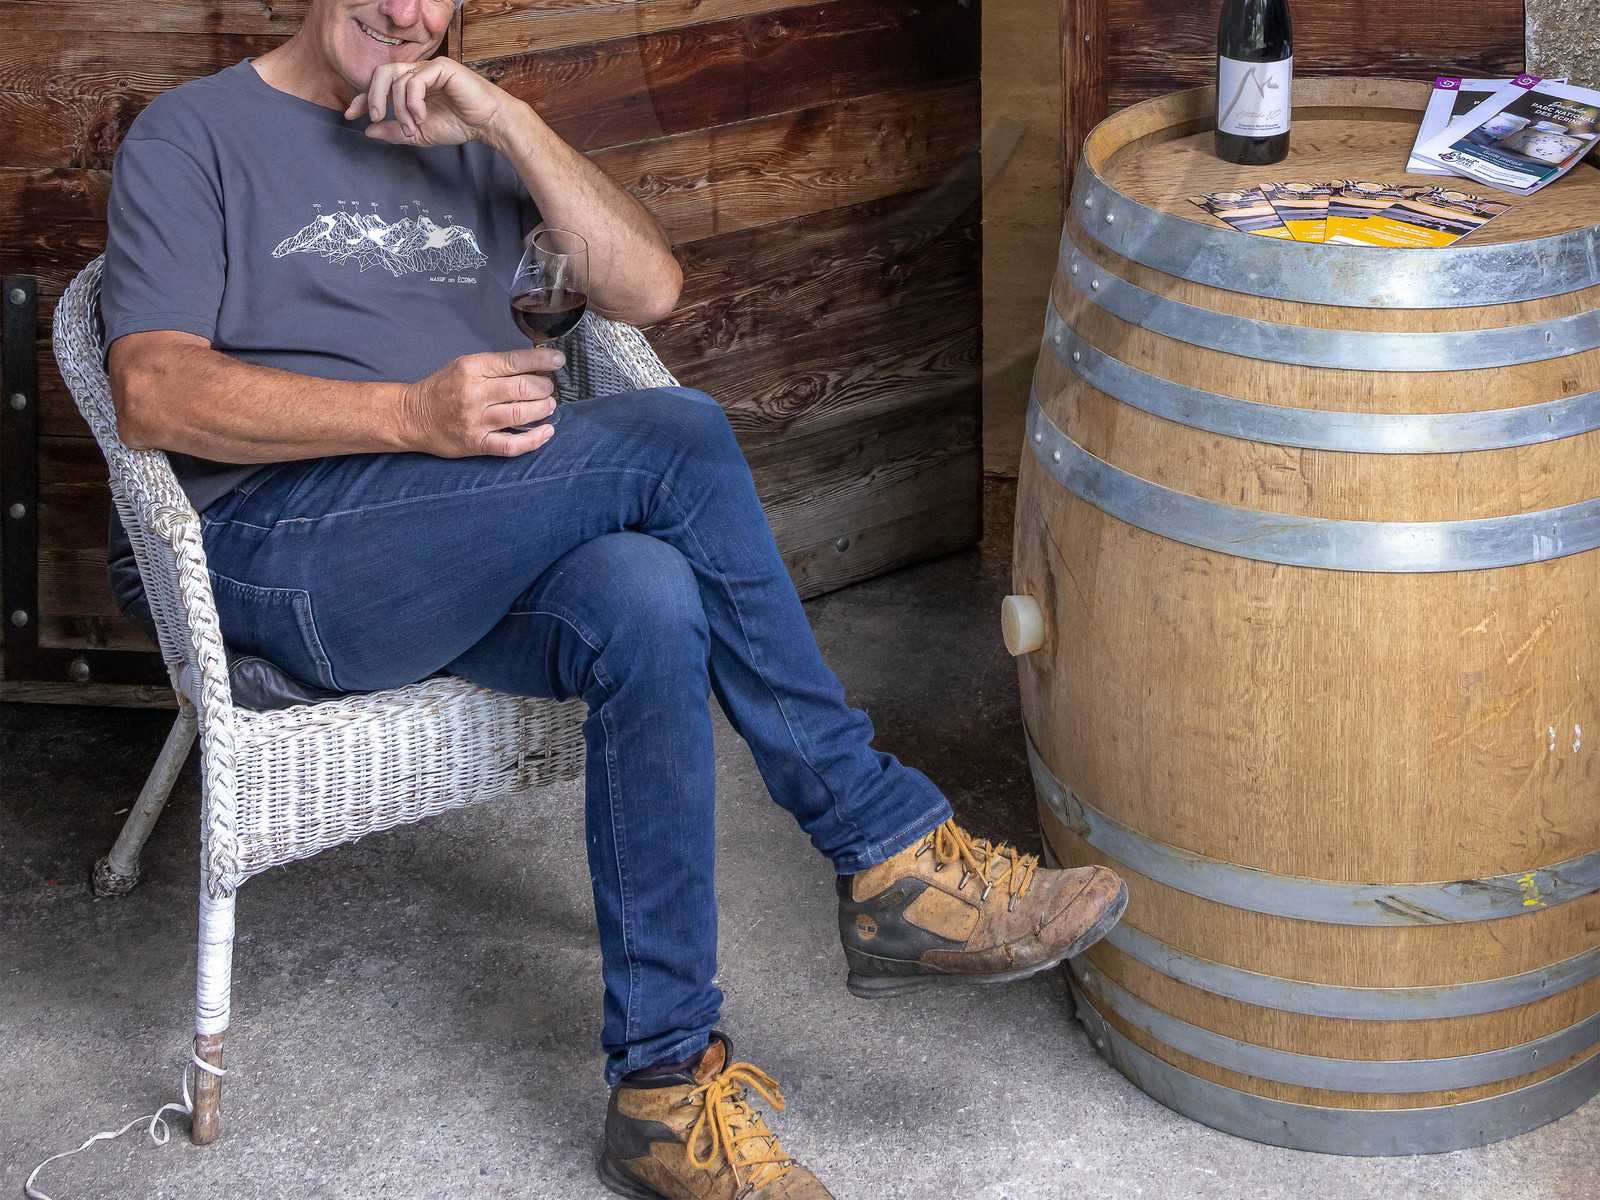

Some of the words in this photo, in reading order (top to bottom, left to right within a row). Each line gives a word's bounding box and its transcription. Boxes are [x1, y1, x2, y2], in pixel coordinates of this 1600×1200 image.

[1530, 102, 1555, 112] PARC
[1554, 109, 1596, 124] NATIONAL
[1534, 109, 1553, 118] DES
[1483, 149, 1500, 159] Guide
